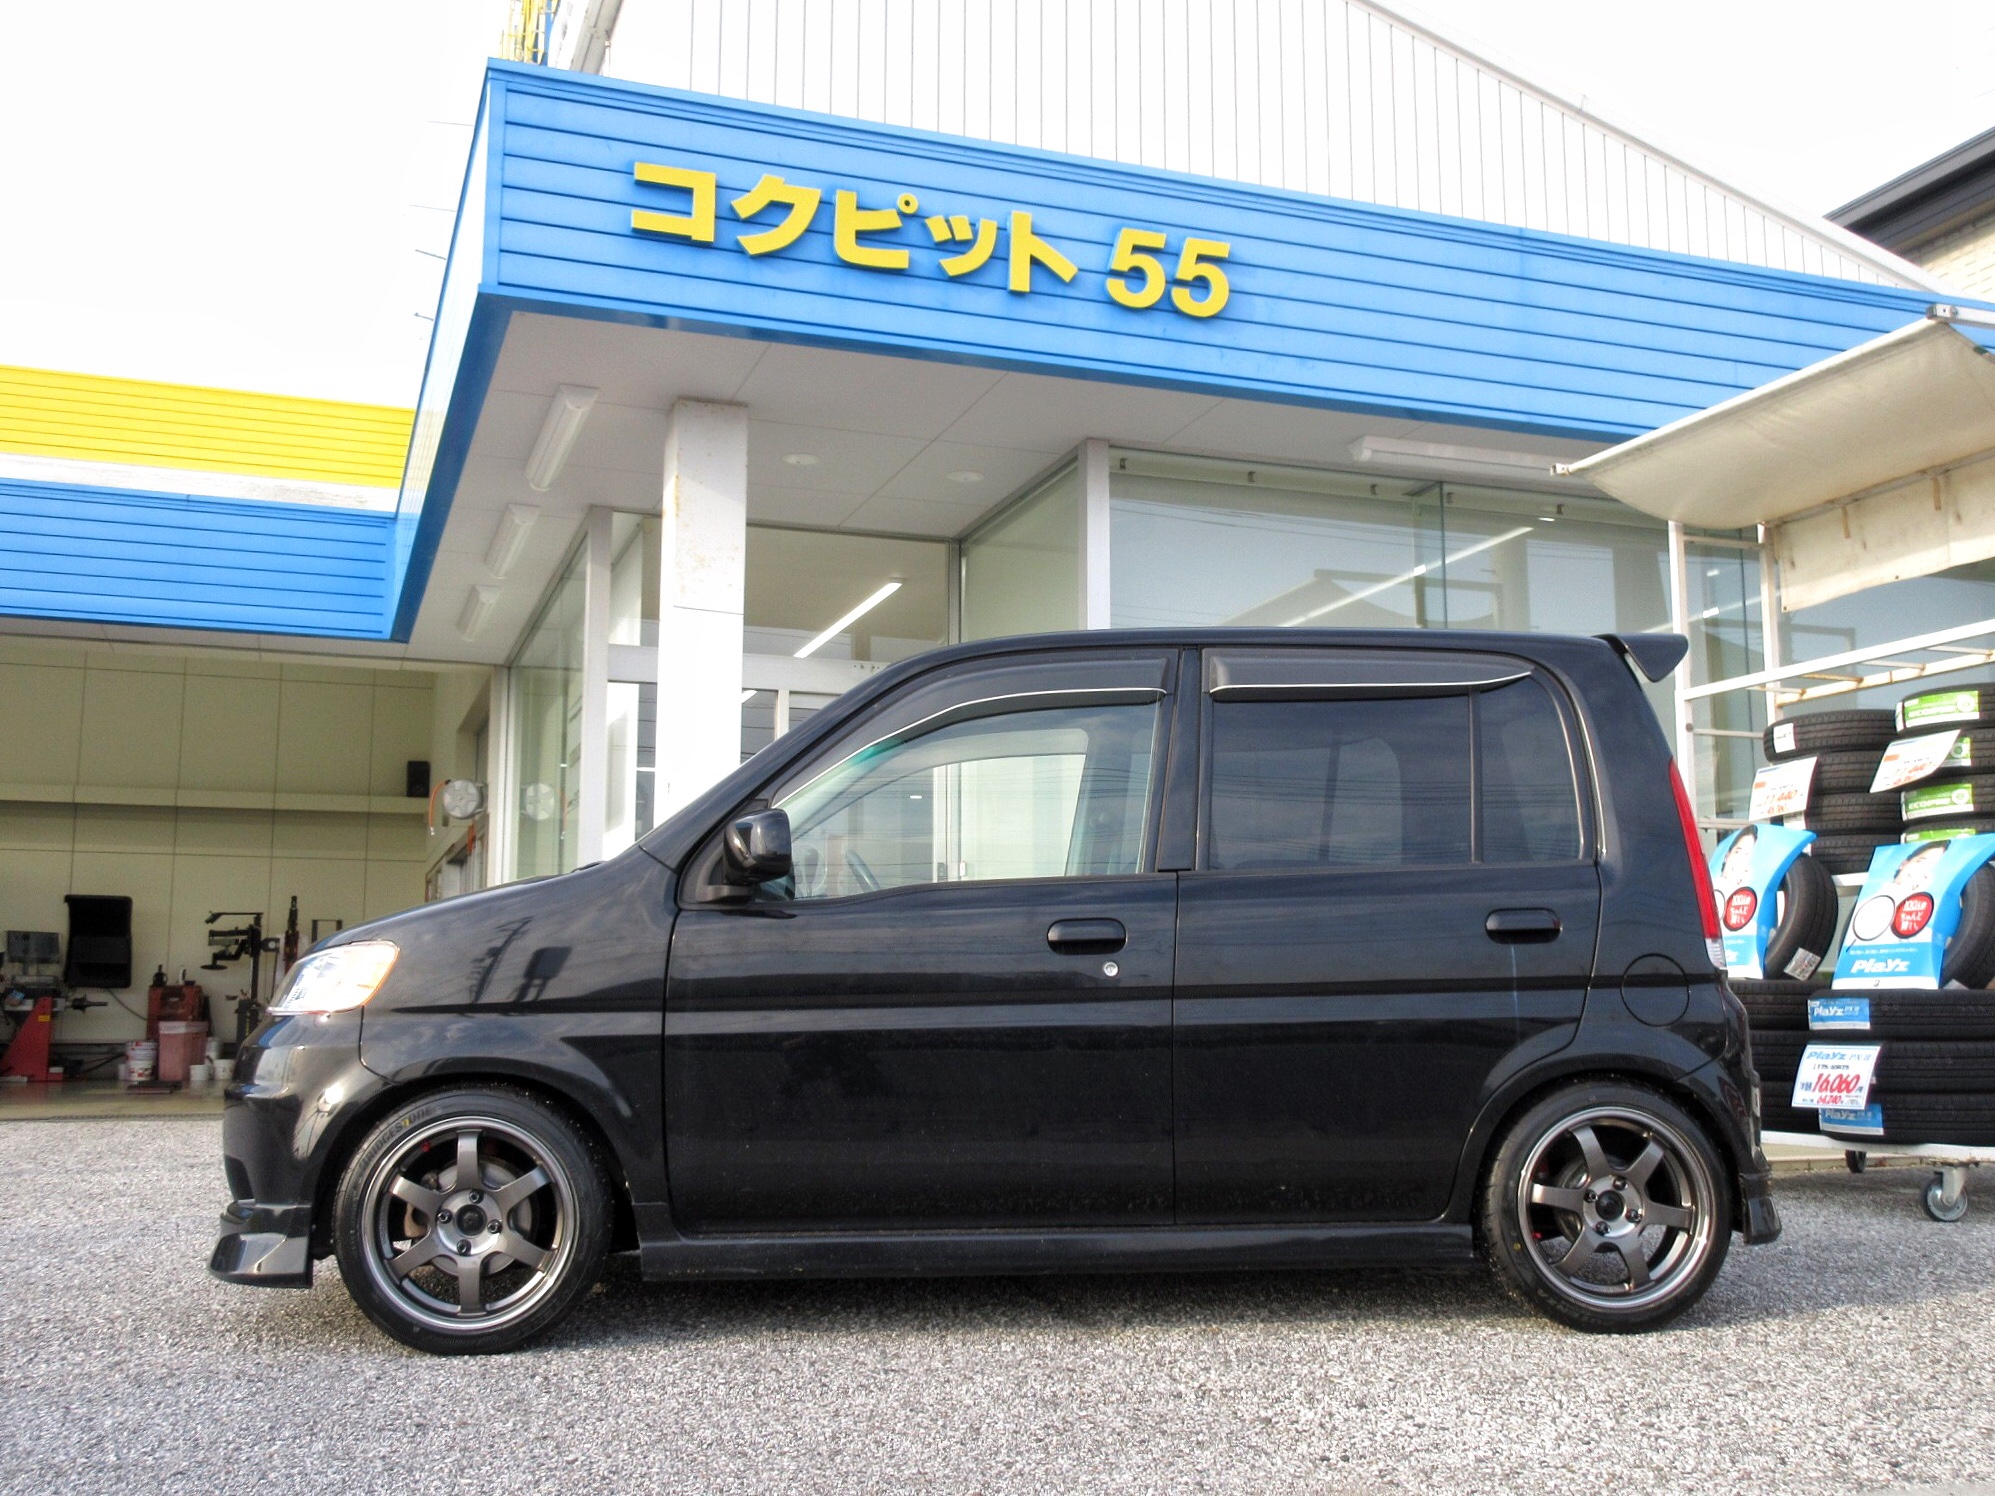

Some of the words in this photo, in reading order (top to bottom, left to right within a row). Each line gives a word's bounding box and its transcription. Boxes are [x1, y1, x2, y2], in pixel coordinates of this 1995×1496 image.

[631, 162, 1078, 293] コクピット
[1106, 228, 1231, 318] 55
